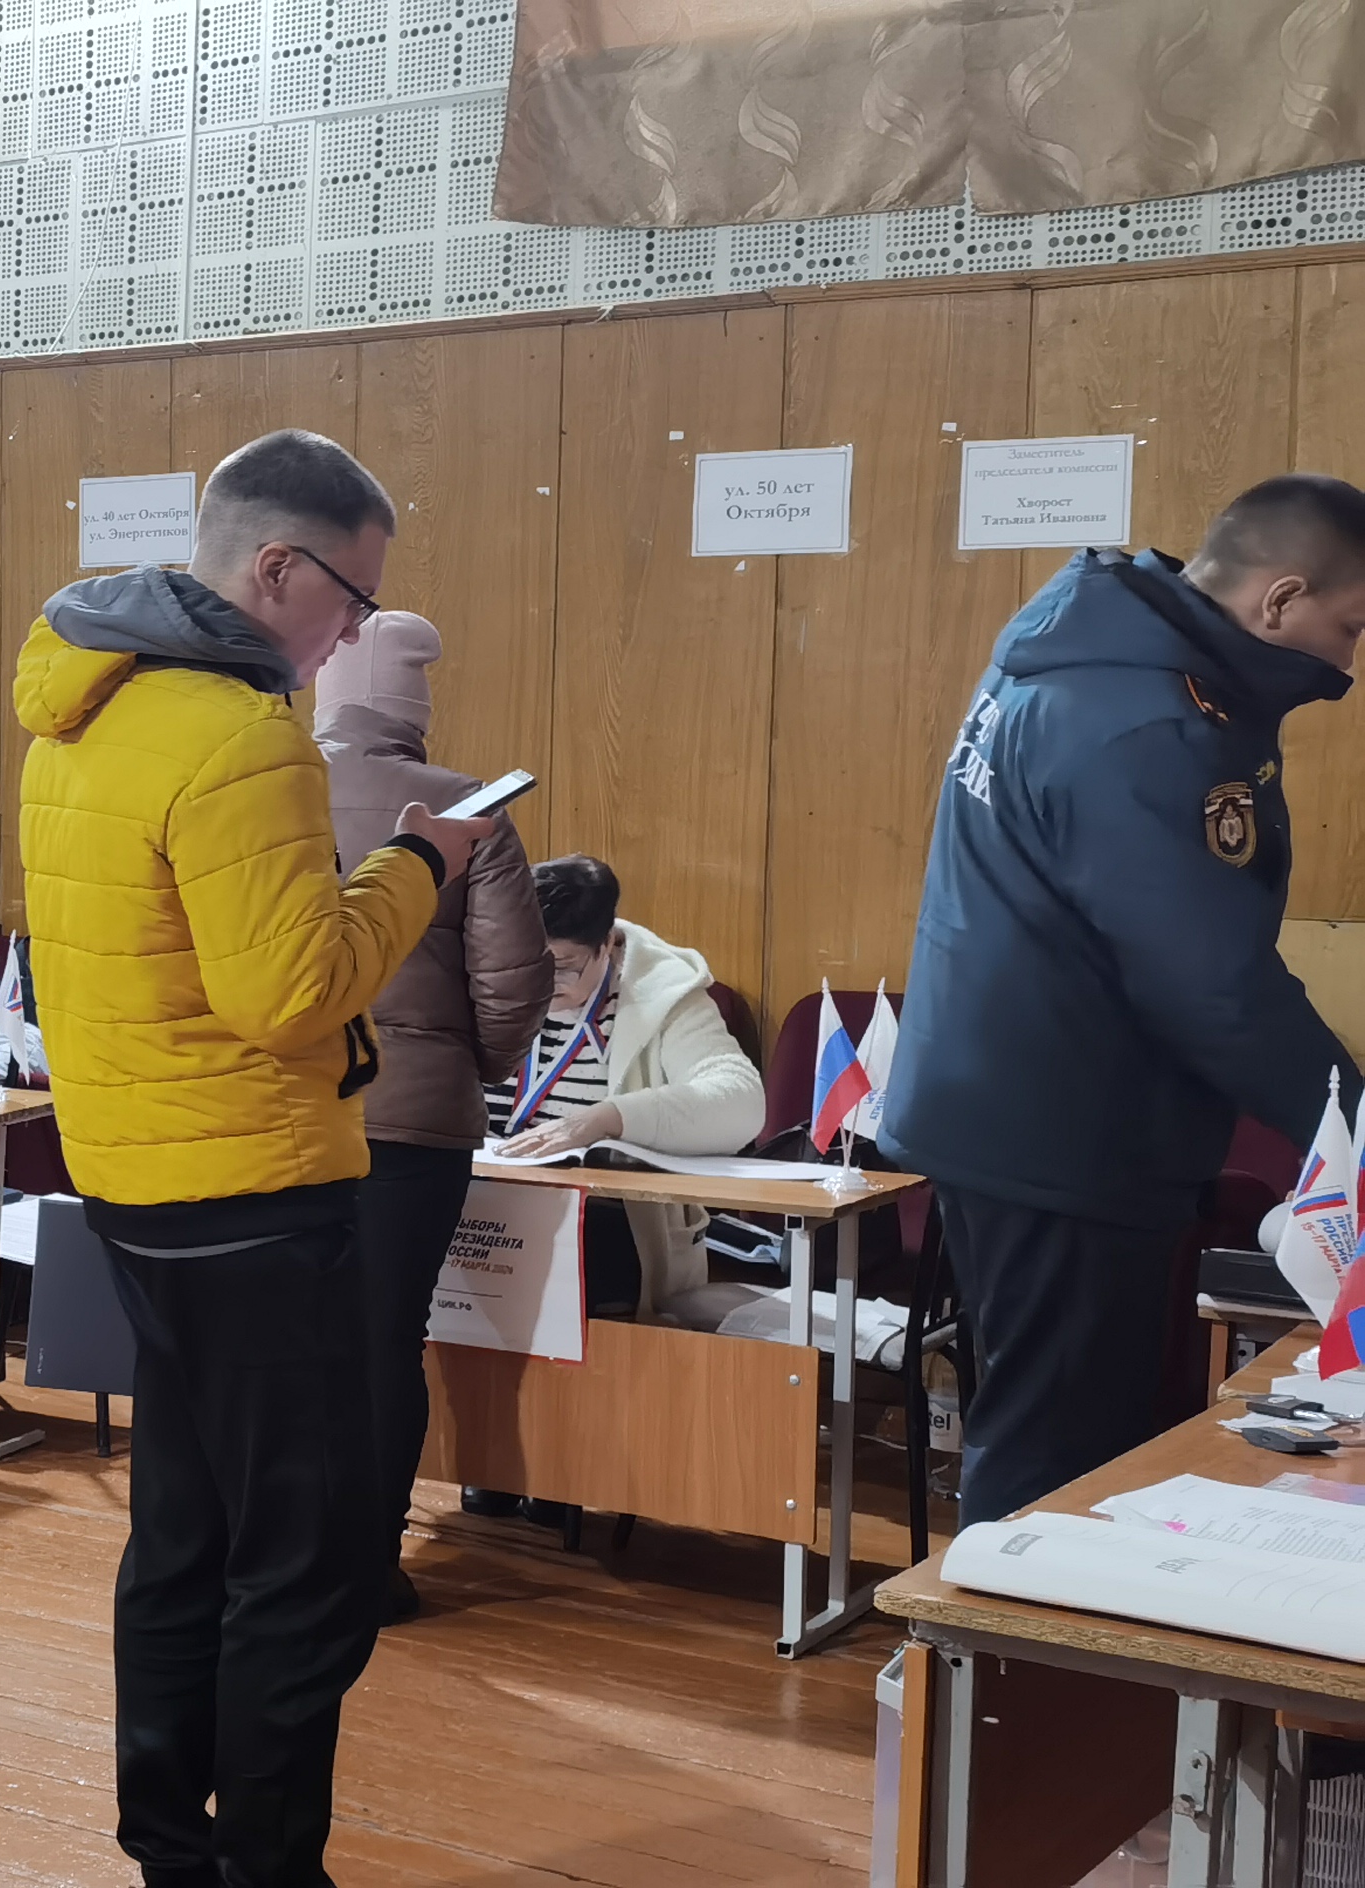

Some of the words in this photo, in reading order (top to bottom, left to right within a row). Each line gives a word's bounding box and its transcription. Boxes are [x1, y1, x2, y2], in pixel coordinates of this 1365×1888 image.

[724, 487, 750, 501] ул.
[756, 480, 777, 495] 50
[782, 482, 815, 494] лет
[1016, 497, 1073, 511] Хворост
[83, 516, 99, 526] ул.
[102, 510, 115, 522] 40
[117, 513, 136, 522] лет
[139, 507, 189, 521] Октября
[726, 503, 811, 522] Октября
[981, 515, 1036, 526] Татьяна
[1039, 513, 1107, 524] Ивановна
[89, 533, 105, 544] ул.
[108, 528, 188, 541] Энергетиков
[459, 1218, 507, 1233] ЫБОРЫ
[453, 1231, 524, 1250] РЕЗИДЕНТА
[1316, 1218, 1350, 1265] РОССИИ
[448, 1245, 490, 1260] ОССИИ
[460, 1260, 490, 1272] МАРТА
